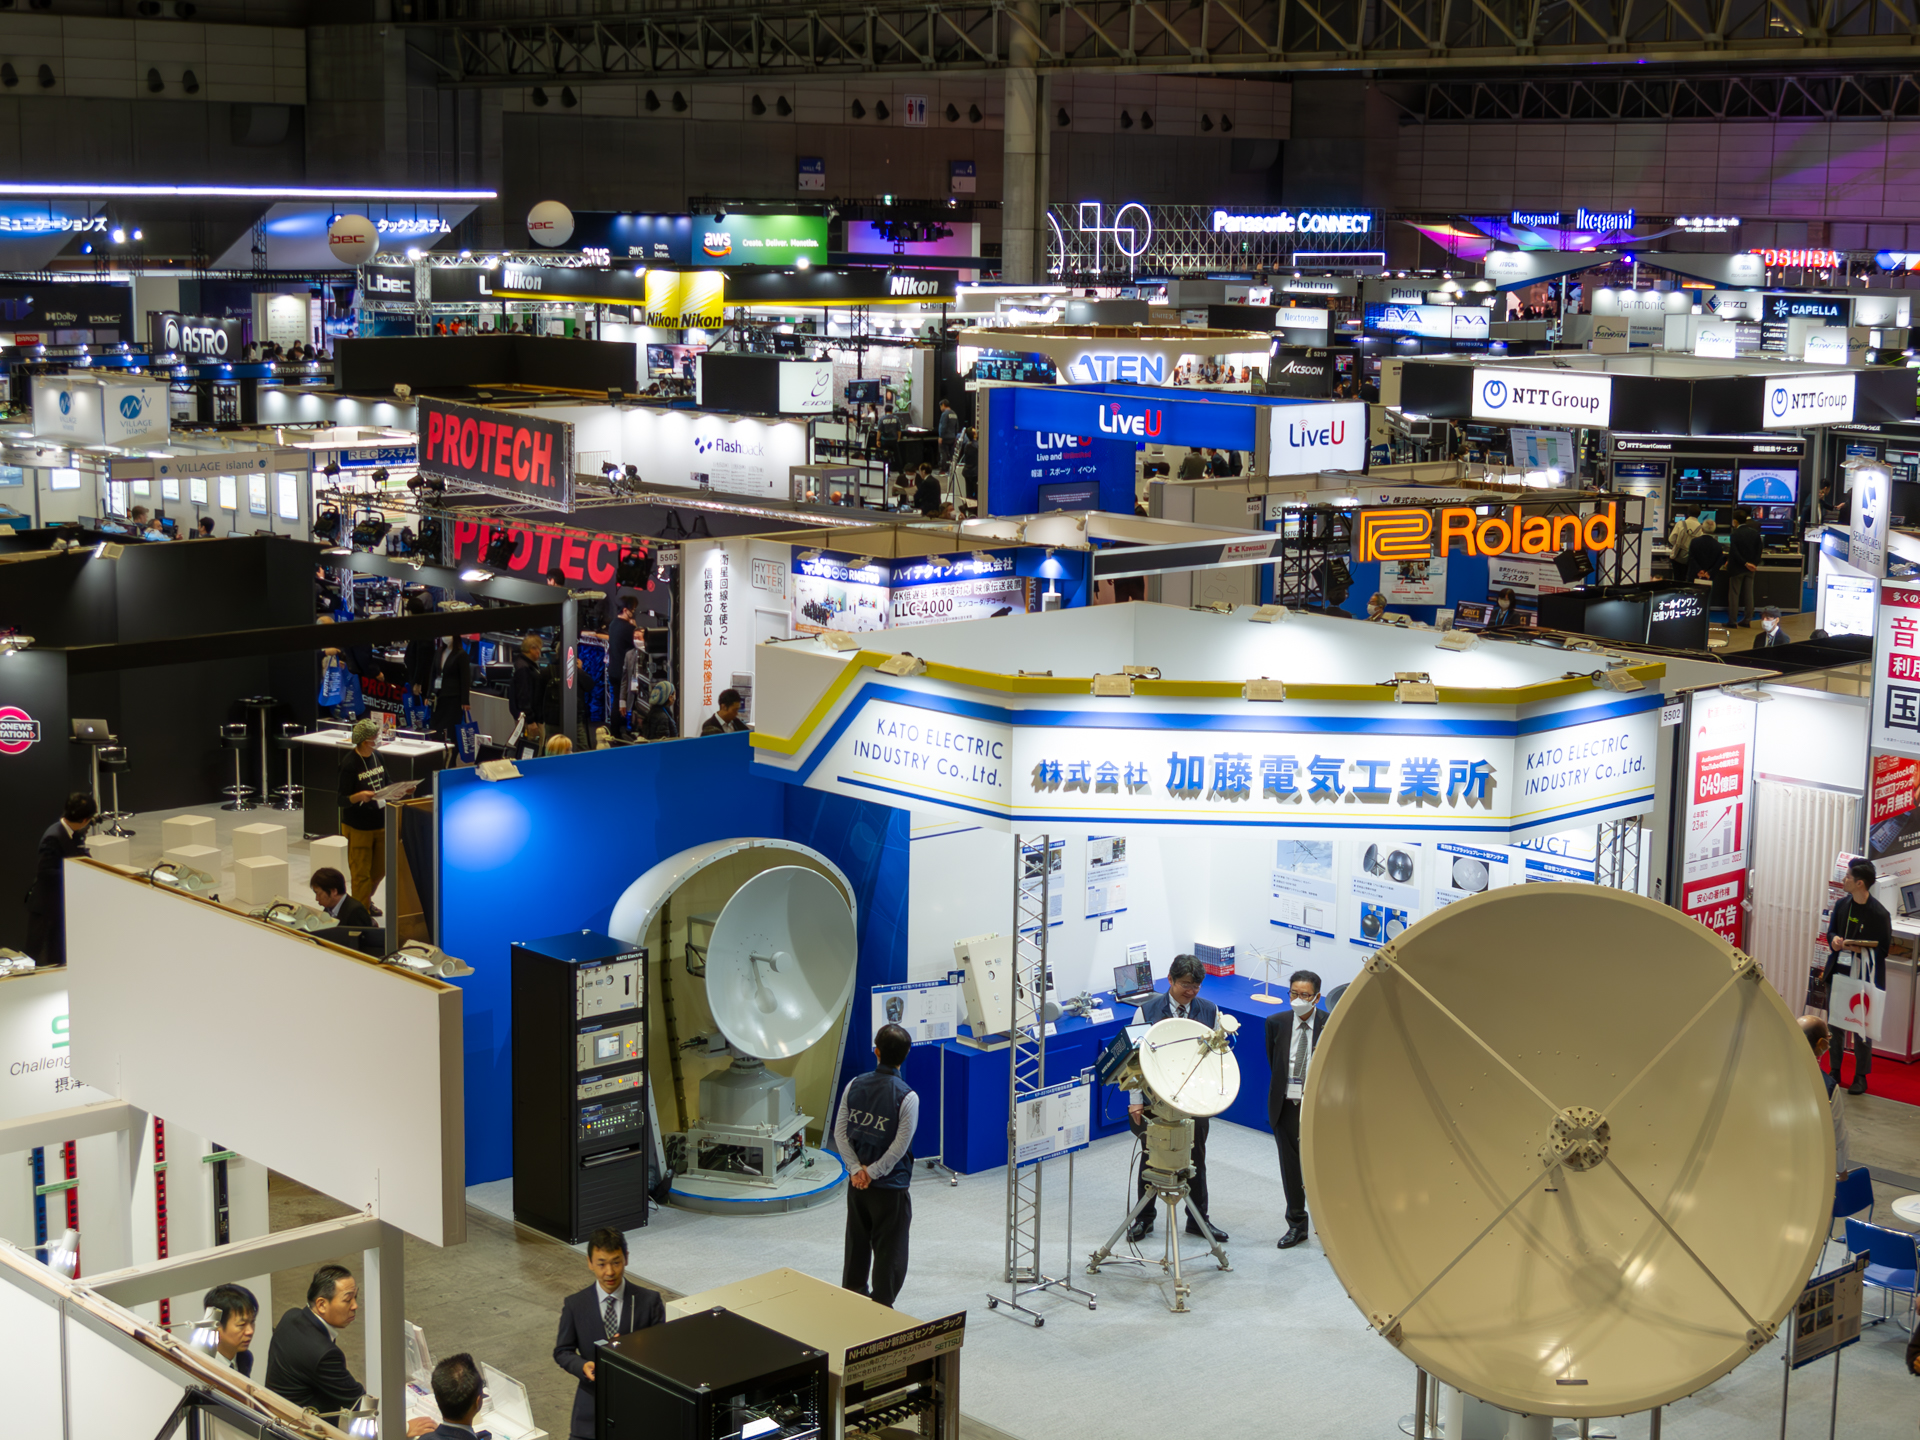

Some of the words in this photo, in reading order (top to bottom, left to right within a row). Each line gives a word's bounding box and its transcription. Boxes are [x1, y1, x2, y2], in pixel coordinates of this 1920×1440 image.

[377, 219, 452, 233] タックシステム
[1213, 210, 1296, 233] Panasonic
[1297, 212, 1371, 233] CONNECT
[1513, 211, 1559, 227] Ikegami
[1577, 208, 1634, 233] Ikegami
[704, 232, 731, 247] aws
[742, 239, 764, 247] Create.
[765, 239, 789, 247] Deliver.
[790, 239, 819, 247] Monetize.
[629, 246, 643, 256] aws
[1750, 249, 1839, 268] TOSHIBA
[367, 274, 411, 294] Libec
[503, 270, 542, 291] Nikon
[890, 276, 938, 296] Nikon
[1290, 279, 1333, 290] Photron
[1391, 287, 1434, 299] Photr
[1617, 295, 1666, 312] harmonic
[1723, 301, 1747, 309] EIZO
[1791, 304, 1838, 316] CAPELLA
[56, 312, 77, 322] Dolby
[647, 311, 679, 328] Nikon
[680, 313, 722, 329] Nikon
[1284, 313, 1318, 323] Nextorage
[182, 326, 228, 355] ASTRO
[1594, 331, 1627, 339] TAIWAN
[1698, 336, 1733, 344] TAIWAN
[1808, 342, 1845, 350] TAIWAN
[1070, 355, 1163, 382] ATEN
[1512, 387, 1549, 405] NTT
[1551, 390, 1600, 413] Group
[1791, 393, 1816, 410] NTT
[1817, 392, 1847, 411] Group
[120, 419, 152, 428] VILLAGE
[126, 427, 148, 435] island
[1289, 419, 1345, 448] LiveU
[426, 410, 550, 488] PROTECH
[716, 438, 764, 456] Flashback
[1037, 453, 1049, 462] Live
[1050, 452, 1062, 461] and
[176, 462, 221, 474] VILLAGE
[225, 459, 254, 471] island
[1049, 467, 1071, 476] スポーツ
[1077, 465, 1097, 474] イベント
[1441, 502, 1616, 558] Roland
[1241, 543, 1267, 552] Kawasaki
[660, 553, 678, 562] 5505
[754, 562, 783, 576] HYTEC
[893, 557, 1013, 581] ハイテクインター株式会社
[755, 574, 783, 588] INTER
[1501, 573, 1530, 583] ディスクラ
[719, 554, 729, 646] 衛星回線を使った
[894, 598, 954, 618] LLC-4000
[1659, 598, 1698, 610] オールインワン
[1652, 606, 1703, 622] 配信ソリューション
[1663, 709, 1681, 722] 5502
[0, 722, 33, 731] ONEWS
[877, 718, 919, 742] KATO
[926, 728, 1004, 760] ELECTRIC
[1526, 747, 1563, 770] KATO
[1568, 734, 1629, 761] ELECTRIC
[854, 739, 930, 771] INDUSTRY
[937, 758, 1003, 788] Co.,Ltd.
[1038, 758, 1149, 786] 株式会社
[1165, 750, 1491, 799] 加藤電気工業所
[1524, 767, 1591, 796] INDUSTRY
[1595, 755, 1646, 780] Co.,Ltd.
[1699, 772, 1739, 798] 649億回
[1731, 852, 1742, 865] 2023
[1696, 886, 1731, 904] 安心の著作権
[627, 951, 643, 961] Electric
[9, 1053, 71, 1076] Challeng
[847, 1107, 892, 1133] KDK
[934, 1337, 961, 1352] SETTSU
